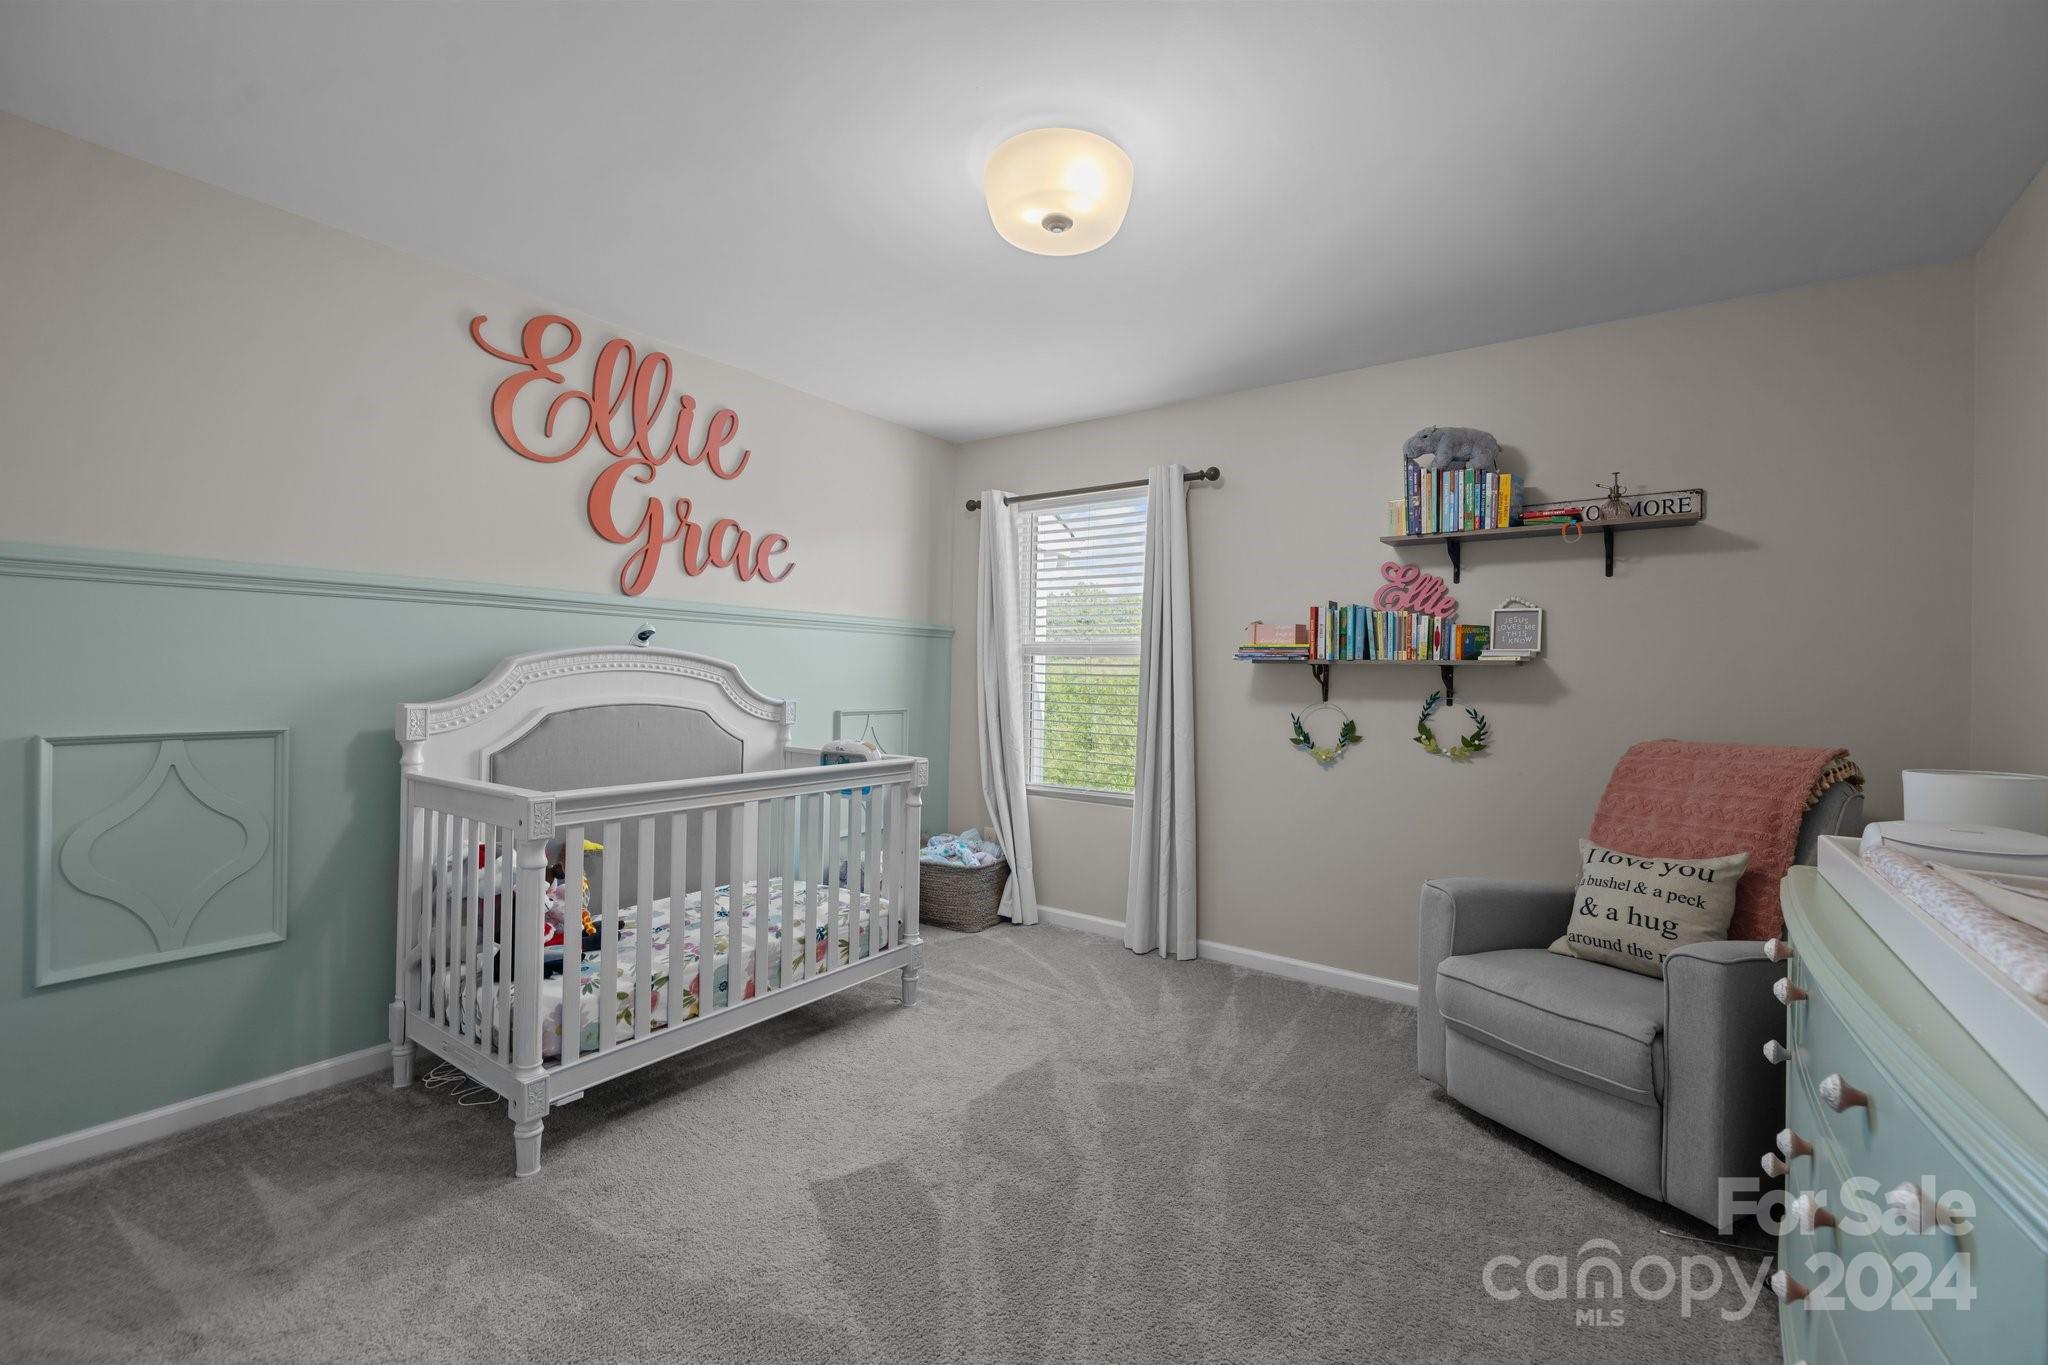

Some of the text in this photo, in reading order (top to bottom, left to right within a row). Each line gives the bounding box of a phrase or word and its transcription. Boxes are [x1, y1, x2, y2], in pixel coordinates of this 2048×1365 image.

[469, 314, 752, 480] Ellie
[1627, 497, 1692, 517] MORE
[587, 458, 796, 597] Grae
[1374, 561, 1458, 618] Ellie
[1505, 616, 1529, 624] JESUS
[1586, 848, 1715, 883] I love you
[1586, 874, 1631, 892] bushel
[1633, 881, 1648, 895] &
[1652, 887, 1662, 898] a
[1665, 891, 1707, 909] peck
[1579, 896, 1680, 940] & a hug
[1568, 931, 1622, 952] around
[1626, 942, 1654, 960] the
